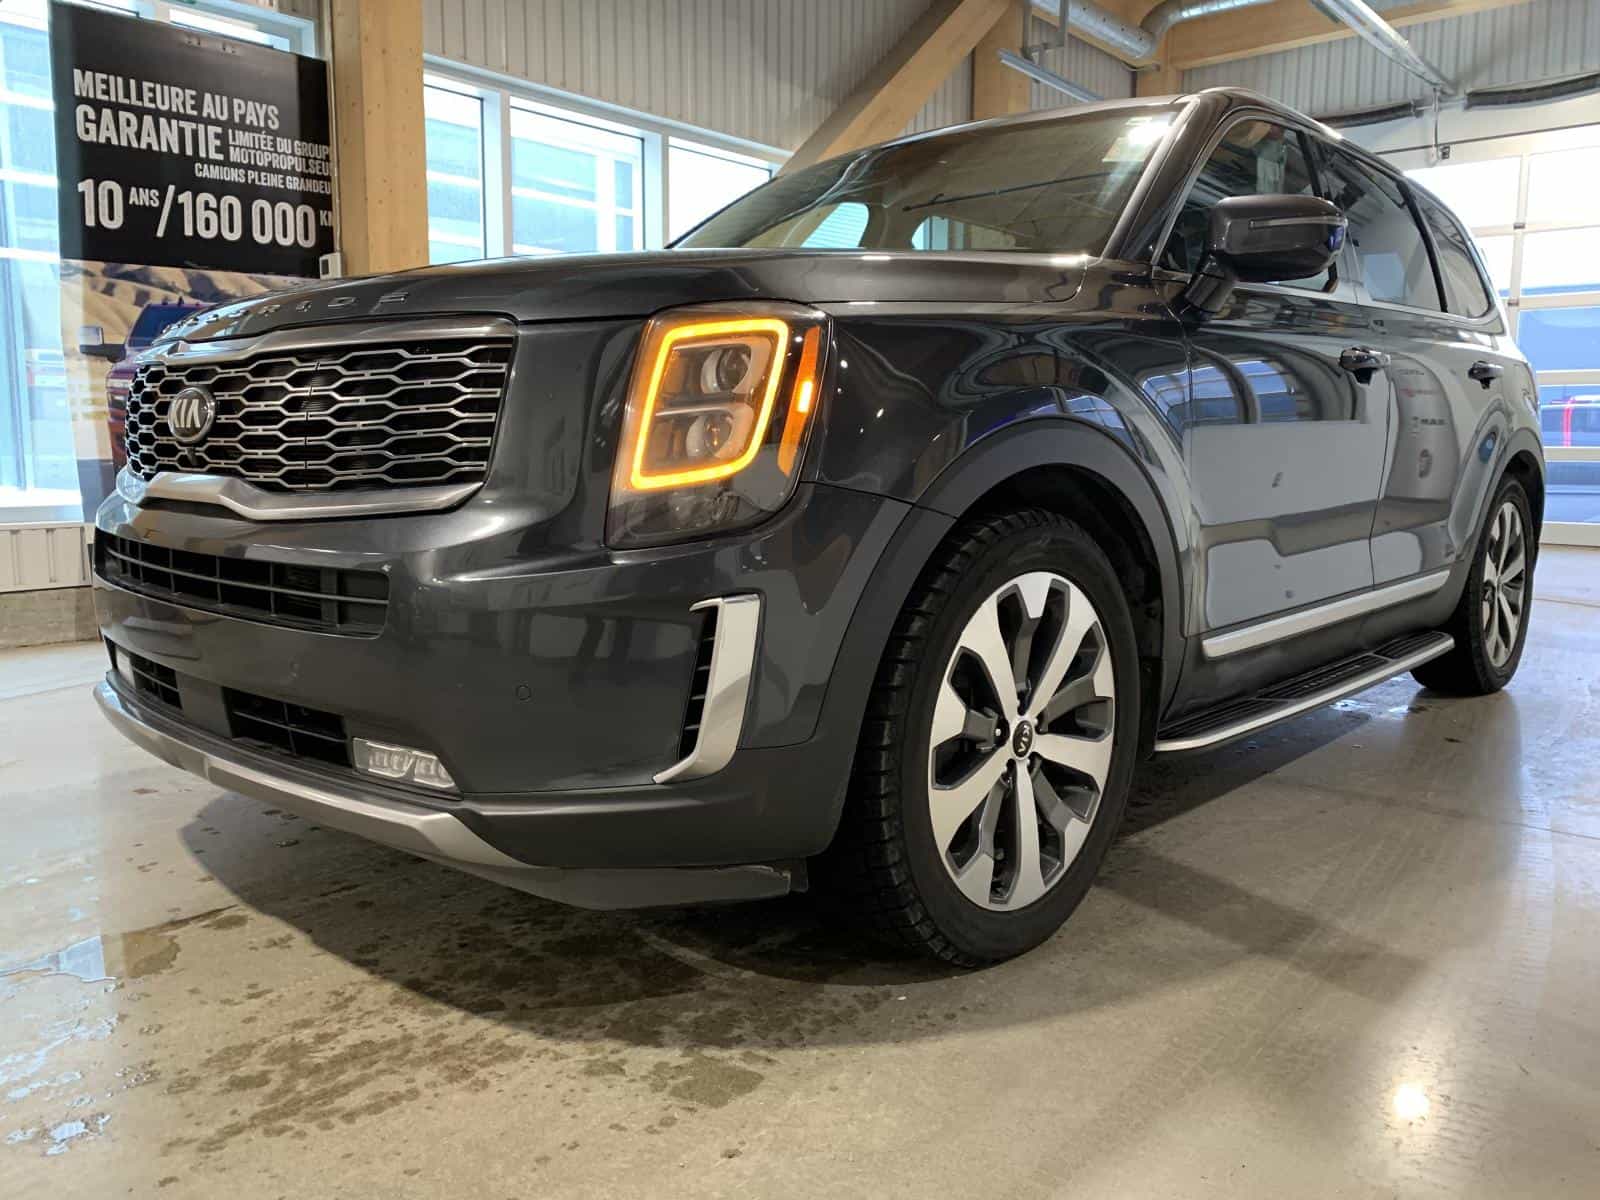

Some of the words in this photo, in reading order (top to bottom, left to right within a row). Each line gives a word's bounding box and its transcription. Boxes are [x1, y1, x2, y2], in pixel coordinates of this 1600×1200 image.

[73, 68, 198, 117] MEILLEURE
[202, 92, 228, 121] AU
[233, 101, 280, 130] PAYS
[76, 104, 225, 161] GARANTIE
[228, 129, 275, 152] LIMITÉE
[276, 137, 292, 154] DU
[294, 139, 330, 161] GROUP
[229, 145, 330, 177] MOTOPROPULSEU
[194, 162, 246, 184] CAMIONS
[247, 170, 285, 189] PLEINE
[285, 176, 332, 195] GRANDEU
[77, 178, 124, 229] 10
[129, 186, 160, 207] ANS
[251, 199, 316, 248] 000
[170, 398, 201, 429] KIA
